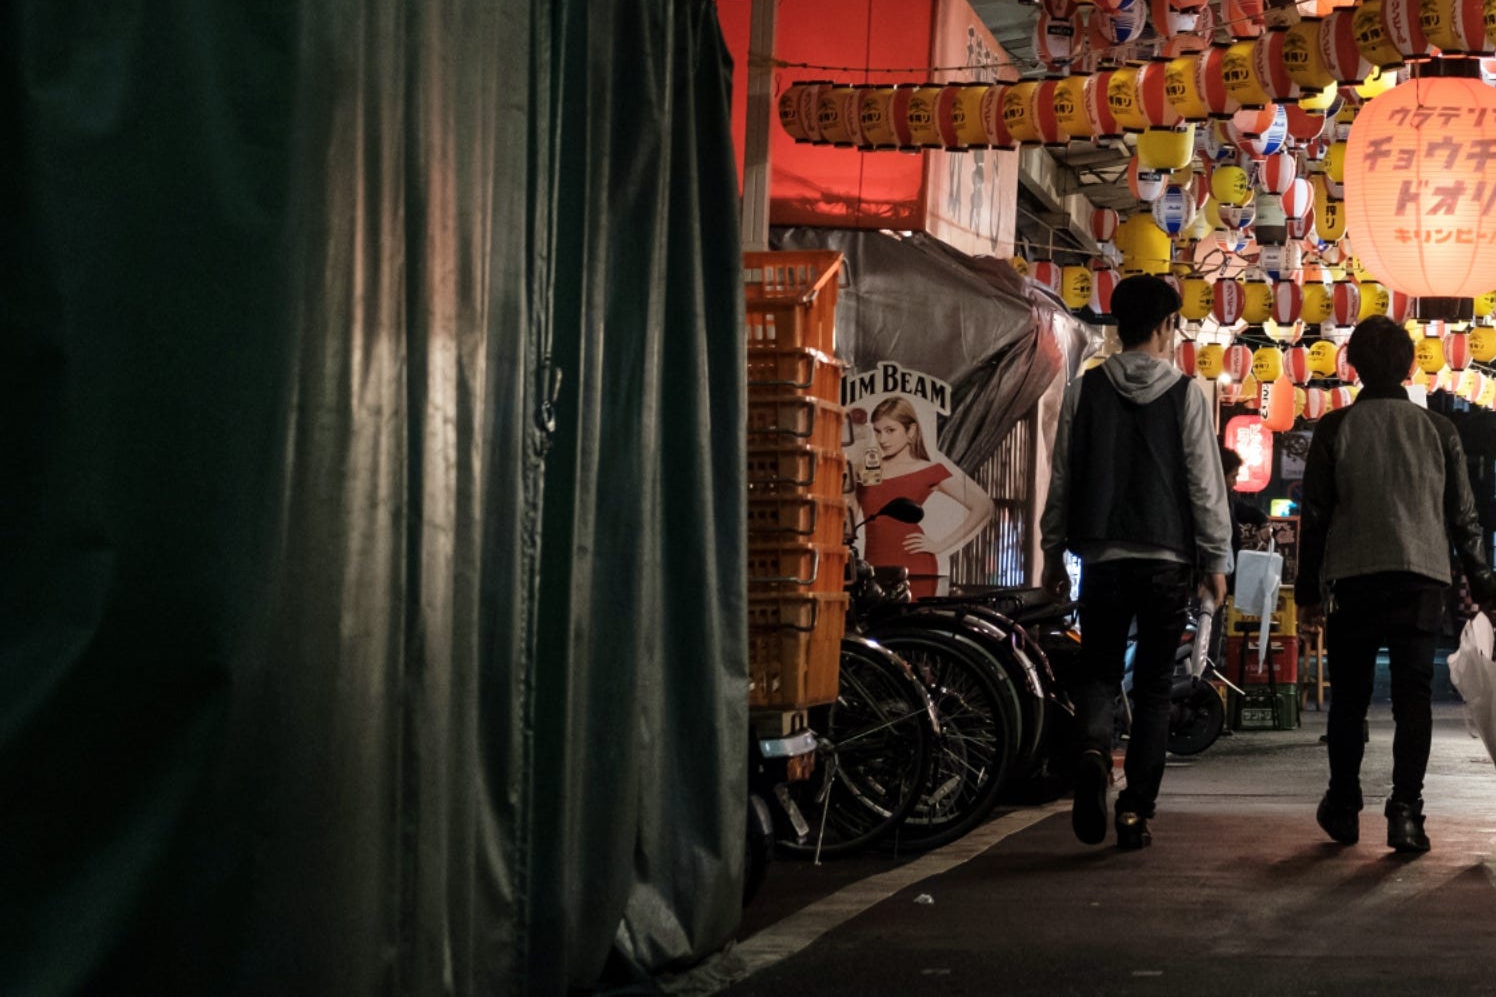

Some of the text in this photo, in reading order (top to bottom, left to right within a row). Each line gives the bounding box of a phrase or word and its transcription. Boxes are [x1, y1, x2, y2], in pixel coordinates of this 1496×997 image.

[1284, 51, 1308, 63] 番搾り
[1223, 70, 1249, 82] 番搾り
[1109, 96, 1132, 108] 番搾り
[883, 364, 947, 409] BEAM
